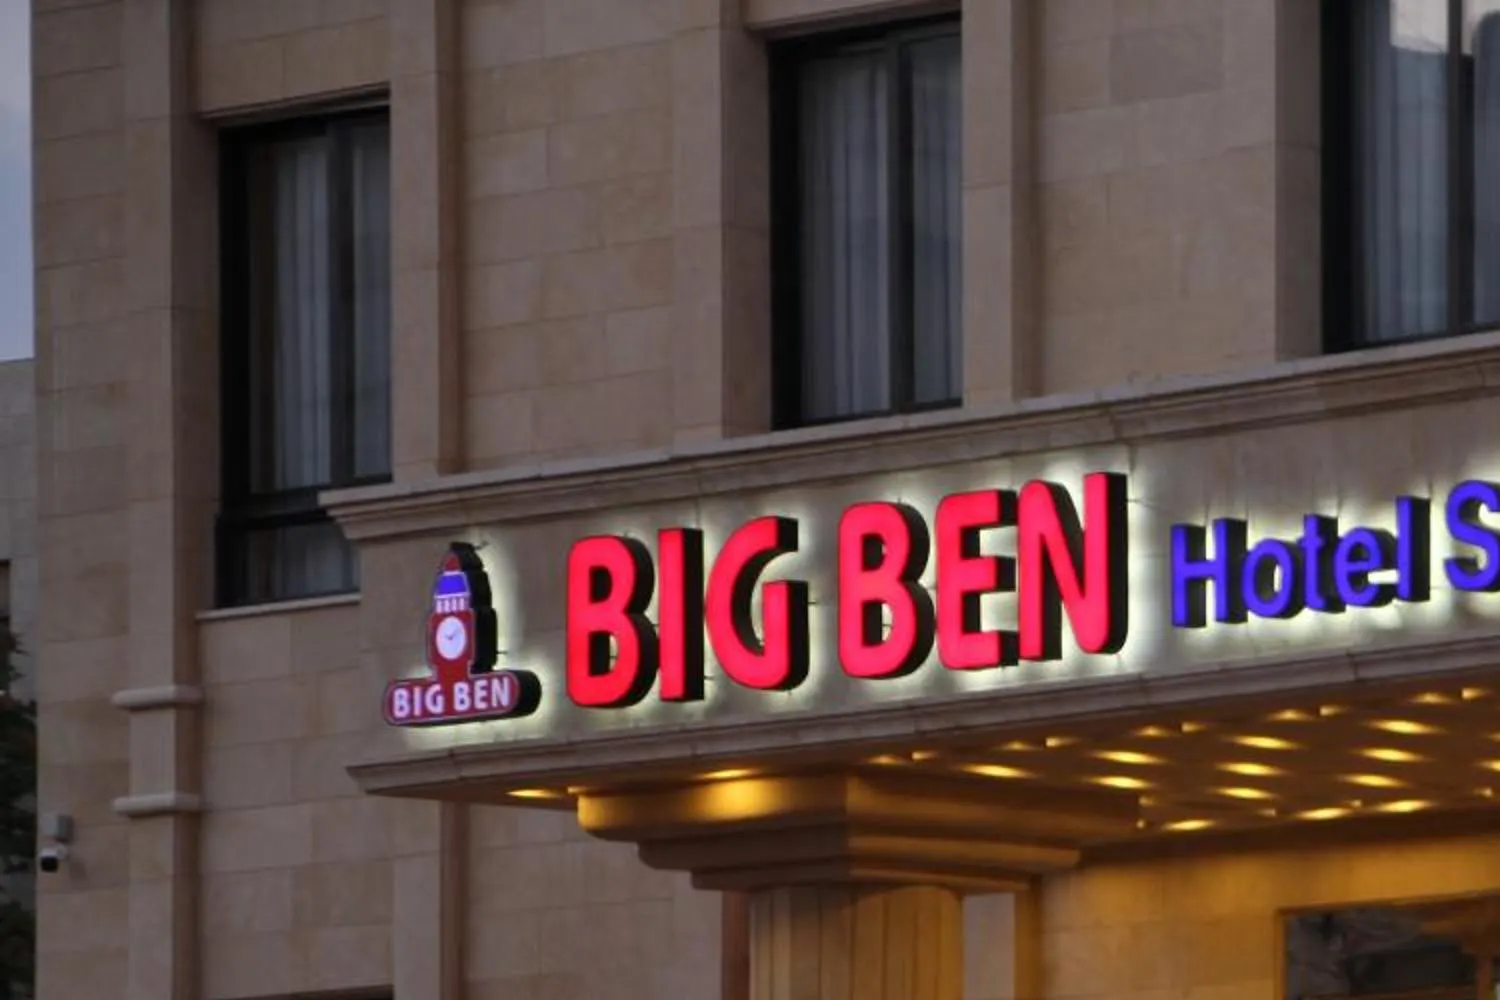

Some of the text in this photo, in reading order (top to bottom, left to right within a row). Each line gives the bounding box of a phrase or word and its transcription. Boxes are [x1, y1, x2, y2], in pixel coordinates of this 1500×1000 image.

[565, 515, 810, 708] BIG
[838, 471, 1128, 680] BEN
[1171, 494, 1430, 628] Hotel
[393, 677, 509, 718] BIG BEN
